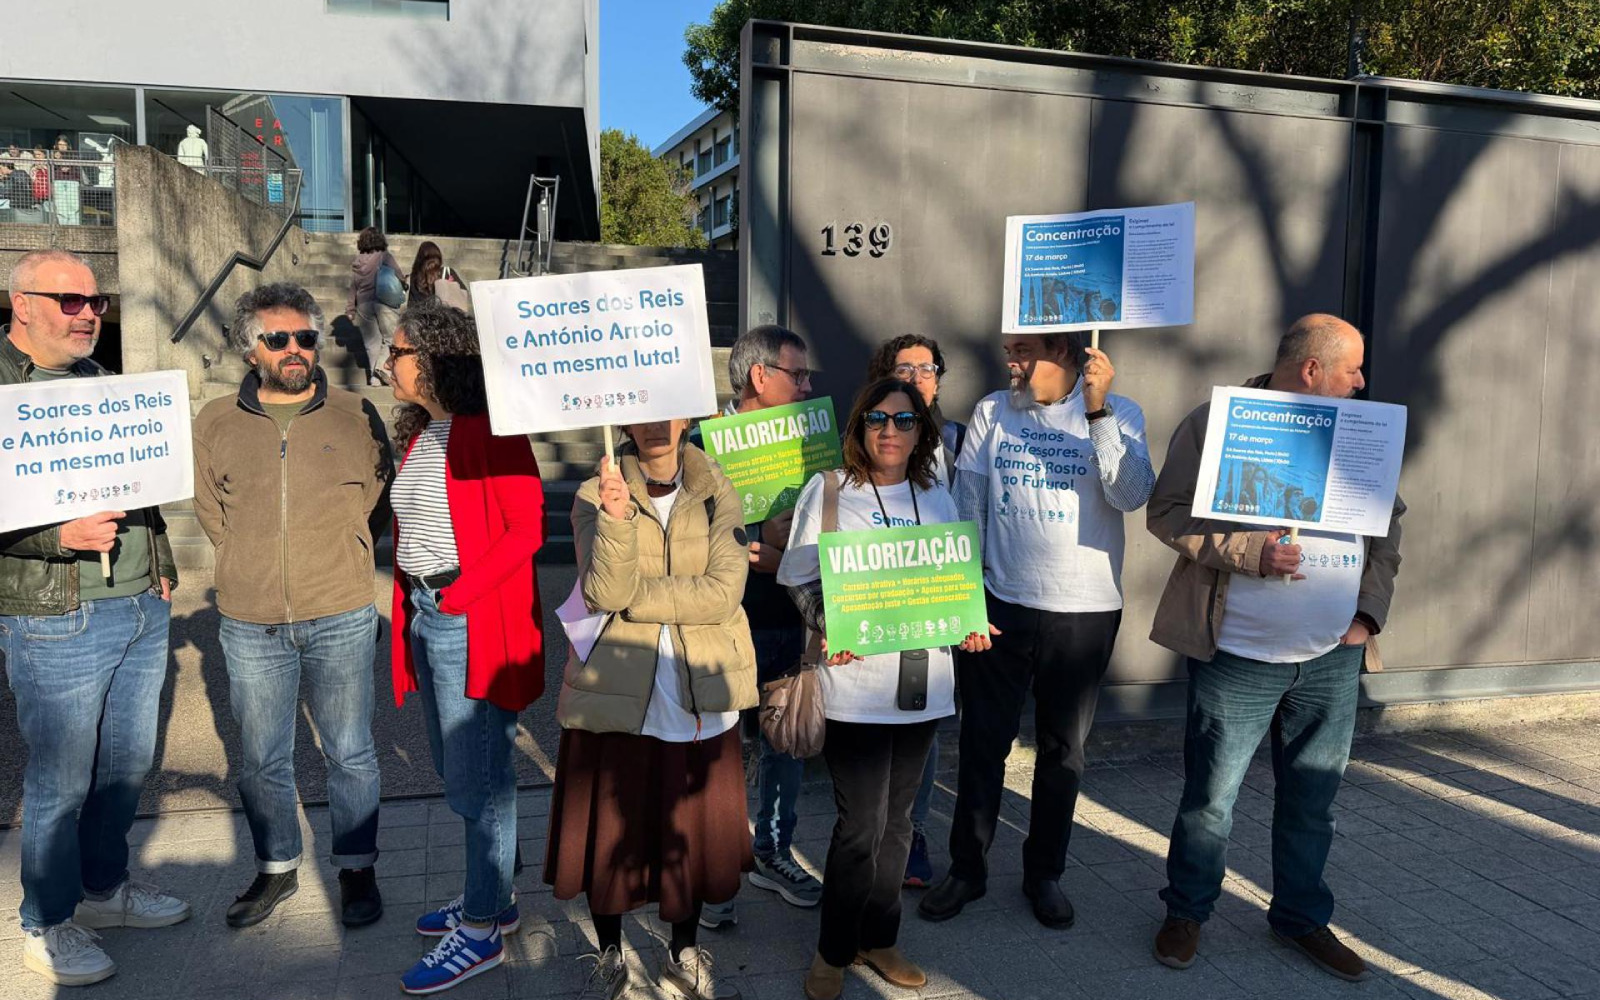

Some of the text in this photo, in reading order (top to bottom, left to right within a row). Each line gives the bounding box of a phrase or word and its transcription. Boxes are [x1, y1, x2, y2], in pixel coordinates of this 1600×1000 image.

[254, 118, 282, 128] E A
[274, 135, 282, 146] R
[820, 220, 893, 258] 139
[1026, 224, 1121, 242] Concentração
[517, 288, 685, 319] Soares dos Reis
[506, 320, 673, 350] e António Arroio
[520, 346, 681, 377] na mesma luta!
[17, 391, 172, 421] Soares dos Reis
[1232, 406, 1332, 428] Concentração
[2, 418, 163, 450] e António Arroio
[710, 406, 831, 456] VALORIZAÇÃO
[1249, 436, 1274, 444] março
[15, 441, 170, 476] na mesma luta!
[998, 441, 1084, 459] Professores.
[994, 456, 1087, 476] Damos Rosto
[1002, 474, 1075, 491] ao Futuro!
[828, 531, 972, 574] VALORIZAÇÃO
